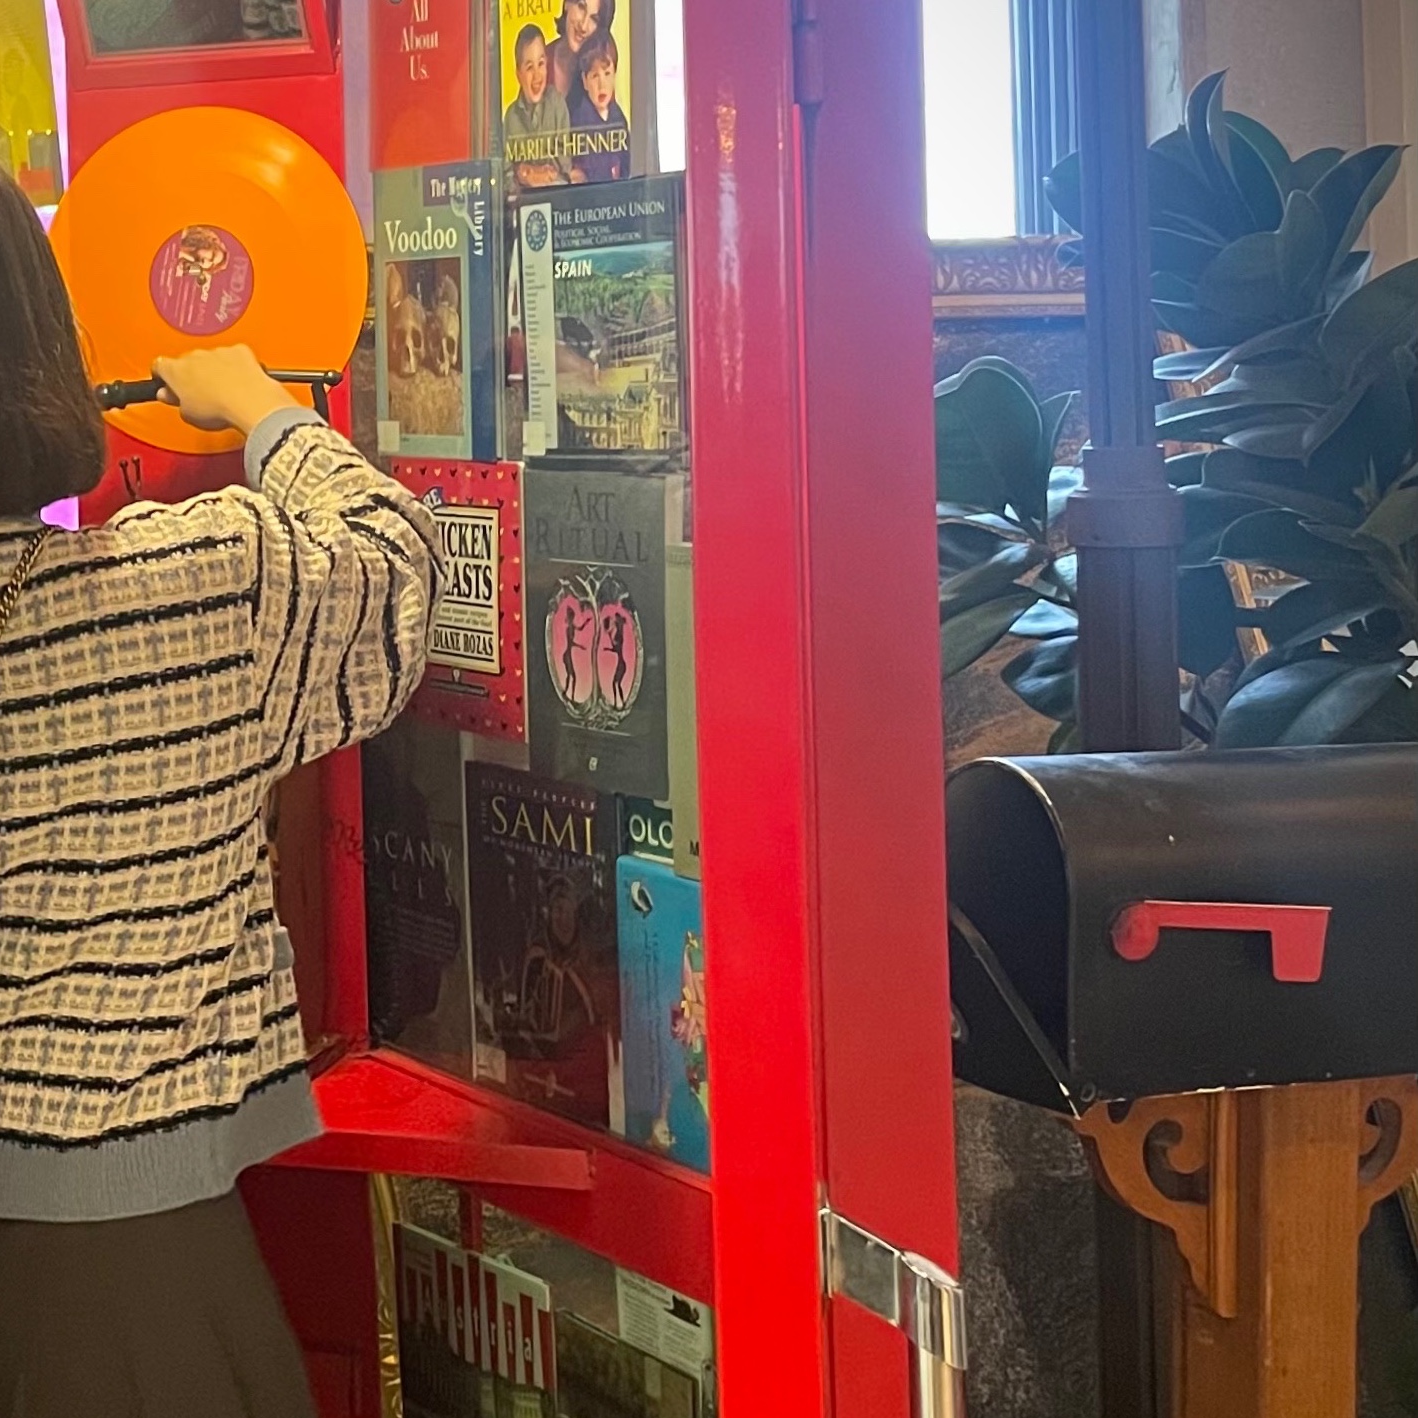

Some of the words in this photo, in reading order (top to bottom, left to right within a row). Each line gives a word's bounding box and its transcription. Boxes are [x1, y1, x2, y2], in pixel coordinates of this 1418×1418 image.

[410, 0, 428, 23] All
[503, 3, 512, 19] A
[400, 27, 439, 52] About
[409, 57, 430, 80] Us.
[505, 133, 559, 162] MARILU
[563, 130, 628, 156] HENNER
[430, 179, 446, 198] The
[553, 211, 572, 226] THE
[574, 205, 627, 223] EUROPEAN
[629, 201, 665, 217] UNION
[384, 216, 457, 254] Voodoo
[473, 201, 485, 256] Library
[554, 259, 592, 279] SPAIN
[567, 486, 614, 522] ART
[536, 517, 648, 562] RITUAL
[433, 629, 461, 652] DIANE
[462, 632, 494, 657] ROZAS
[491, 795, 593, 857] SAMI
[423, 1280, 533, 1362] Austria
